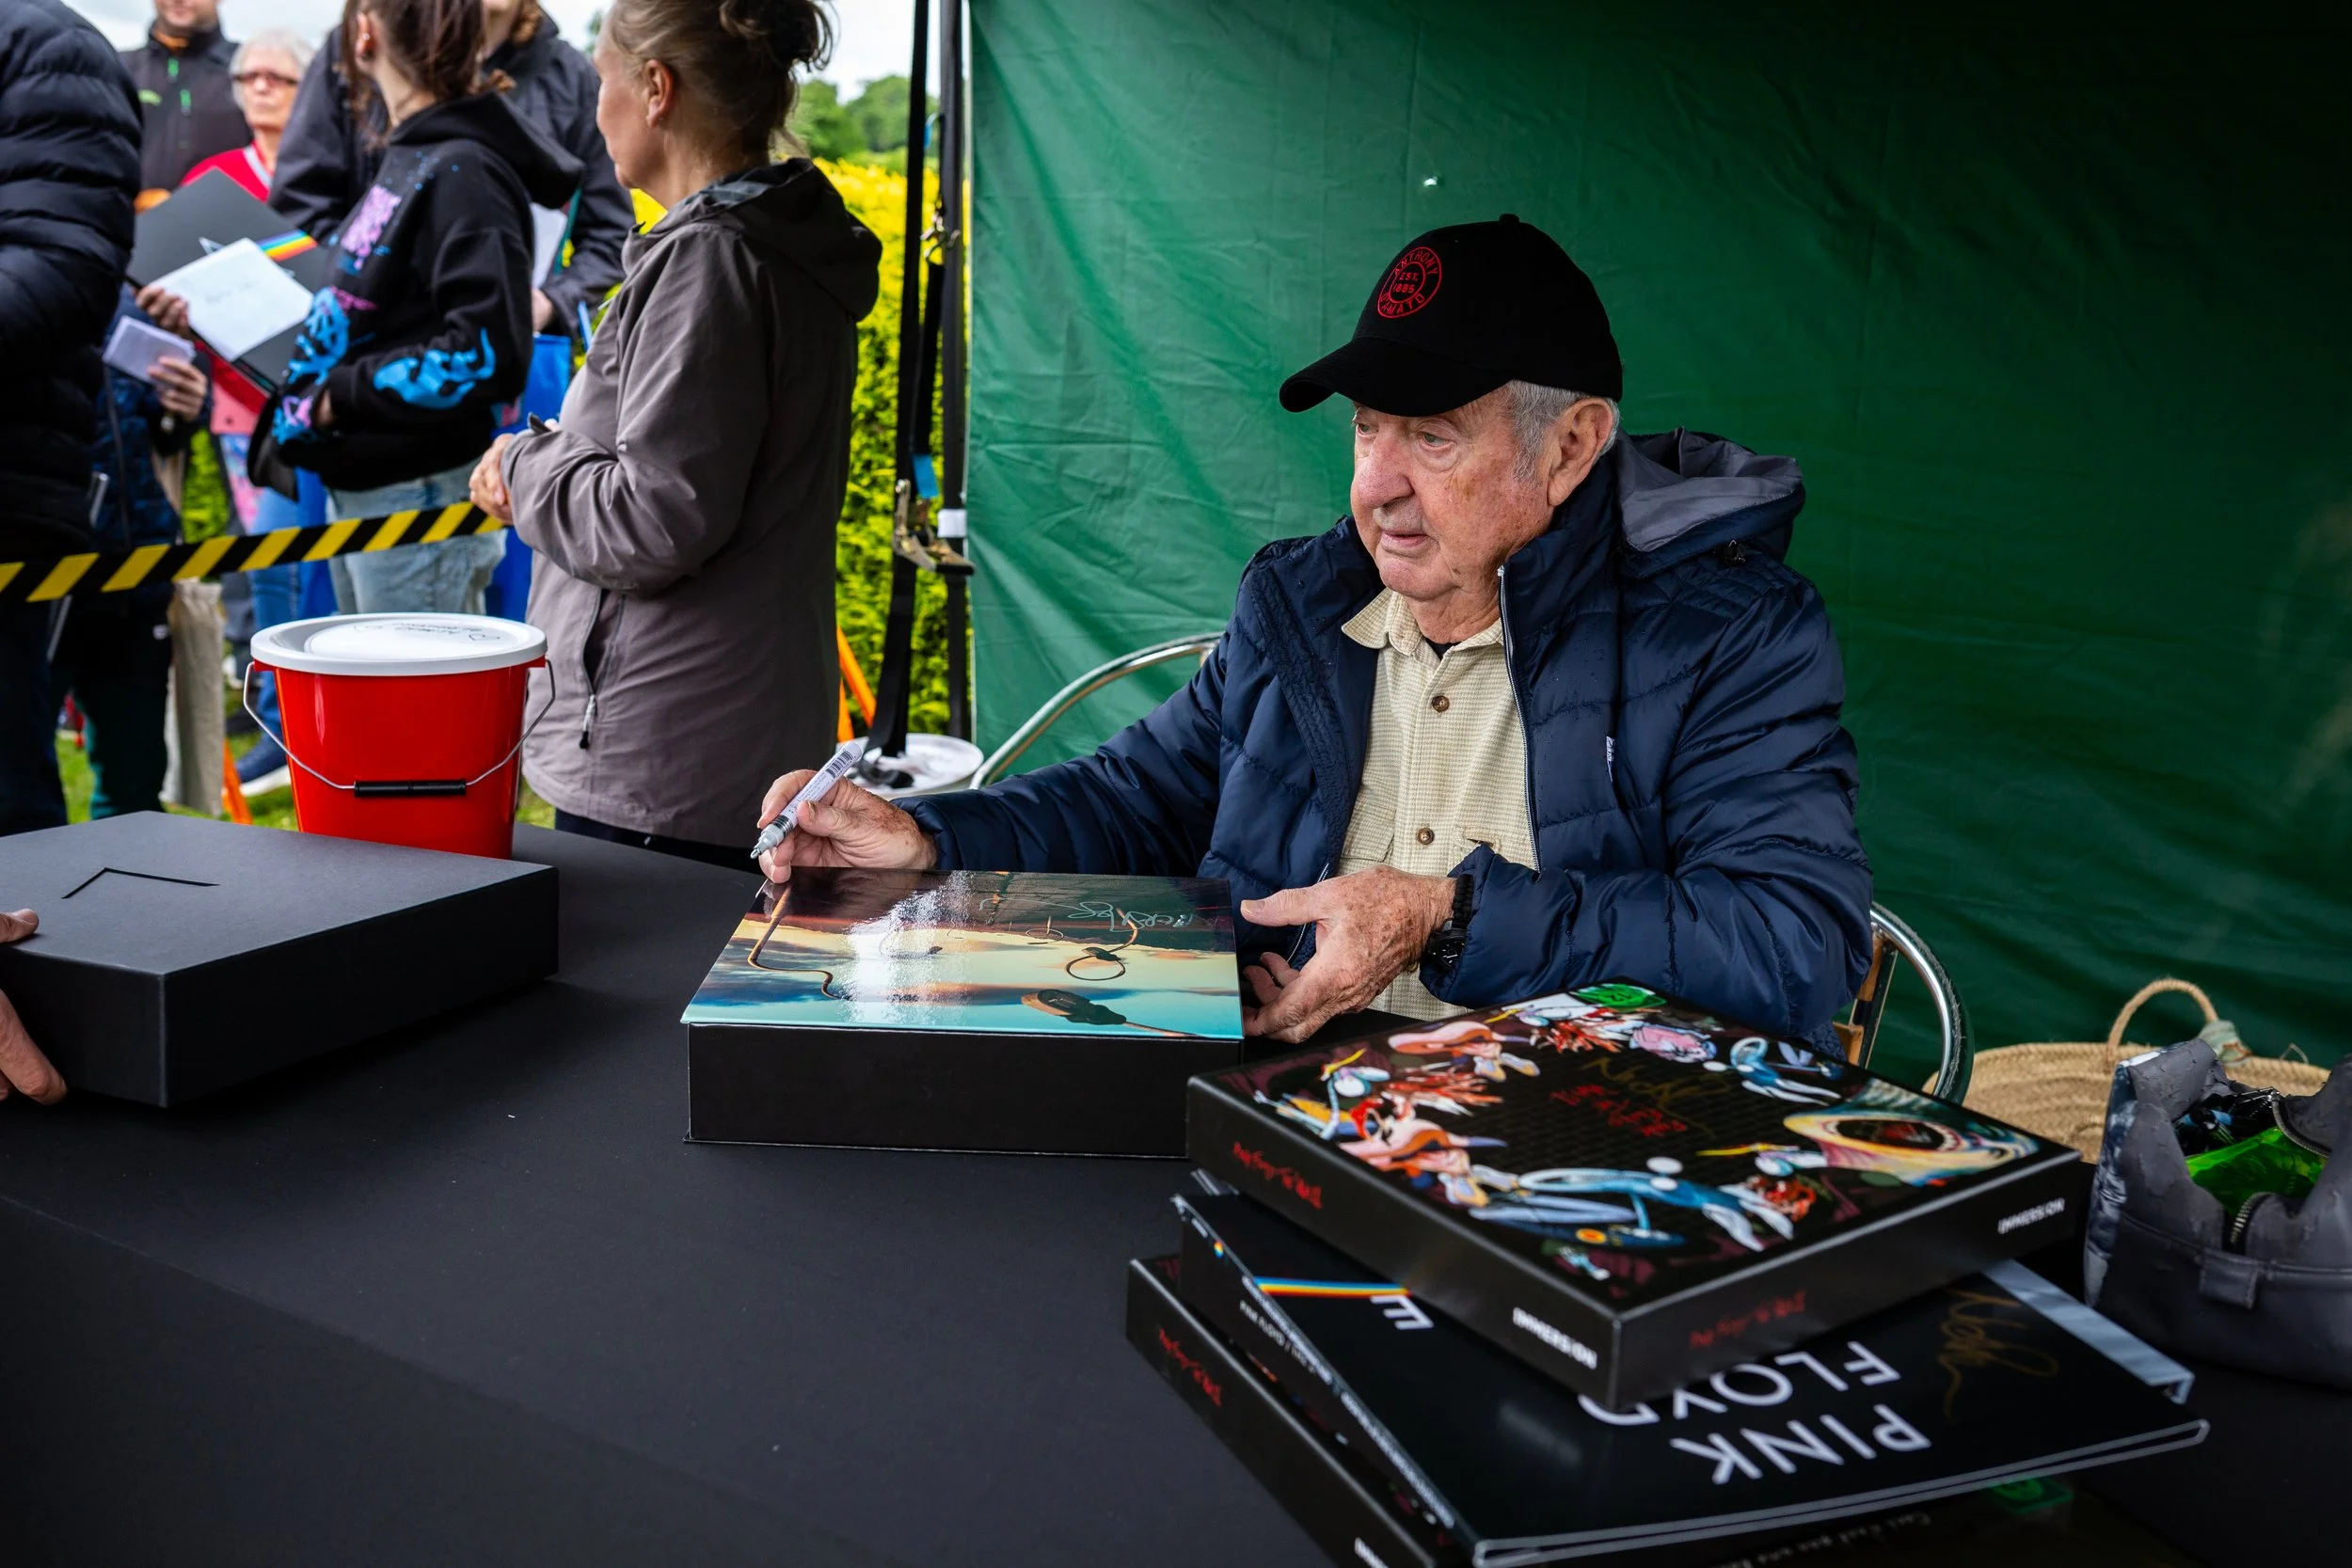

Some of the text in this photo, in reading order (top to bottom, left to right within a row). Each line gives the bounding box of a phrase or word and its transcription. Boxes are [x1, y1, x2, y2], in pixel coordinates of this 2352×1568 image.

[1394, 250, 1438, 276] ANTHONY
[1392, 283, 1416, 293] 1885
[1669, 1403, 1931, 1485] PINK
